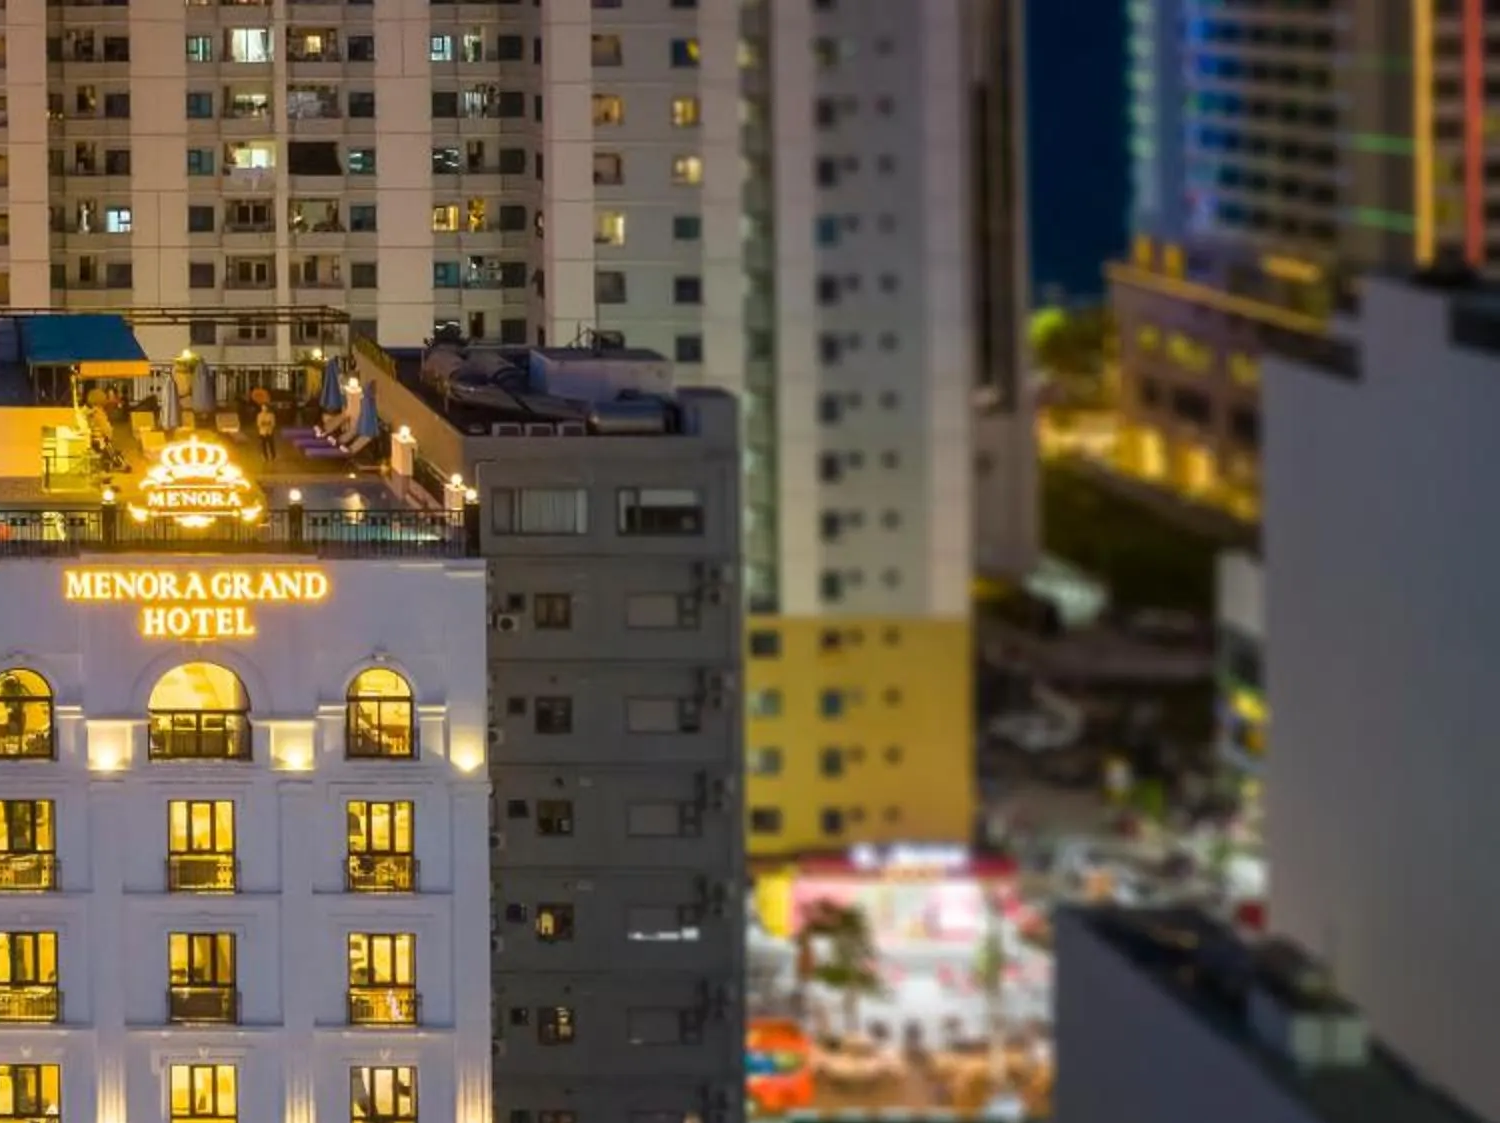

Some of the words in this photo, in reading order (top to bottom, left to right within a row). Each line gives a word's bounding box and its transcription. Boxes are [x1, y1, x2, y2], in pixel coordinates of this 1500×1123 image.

[146, 491, 242, 507] MENORA
[64, 571, 207, 600] MENORA
[211, 571, 328, 600] GRAND
[142, 607, 256, 636] HOTEL
